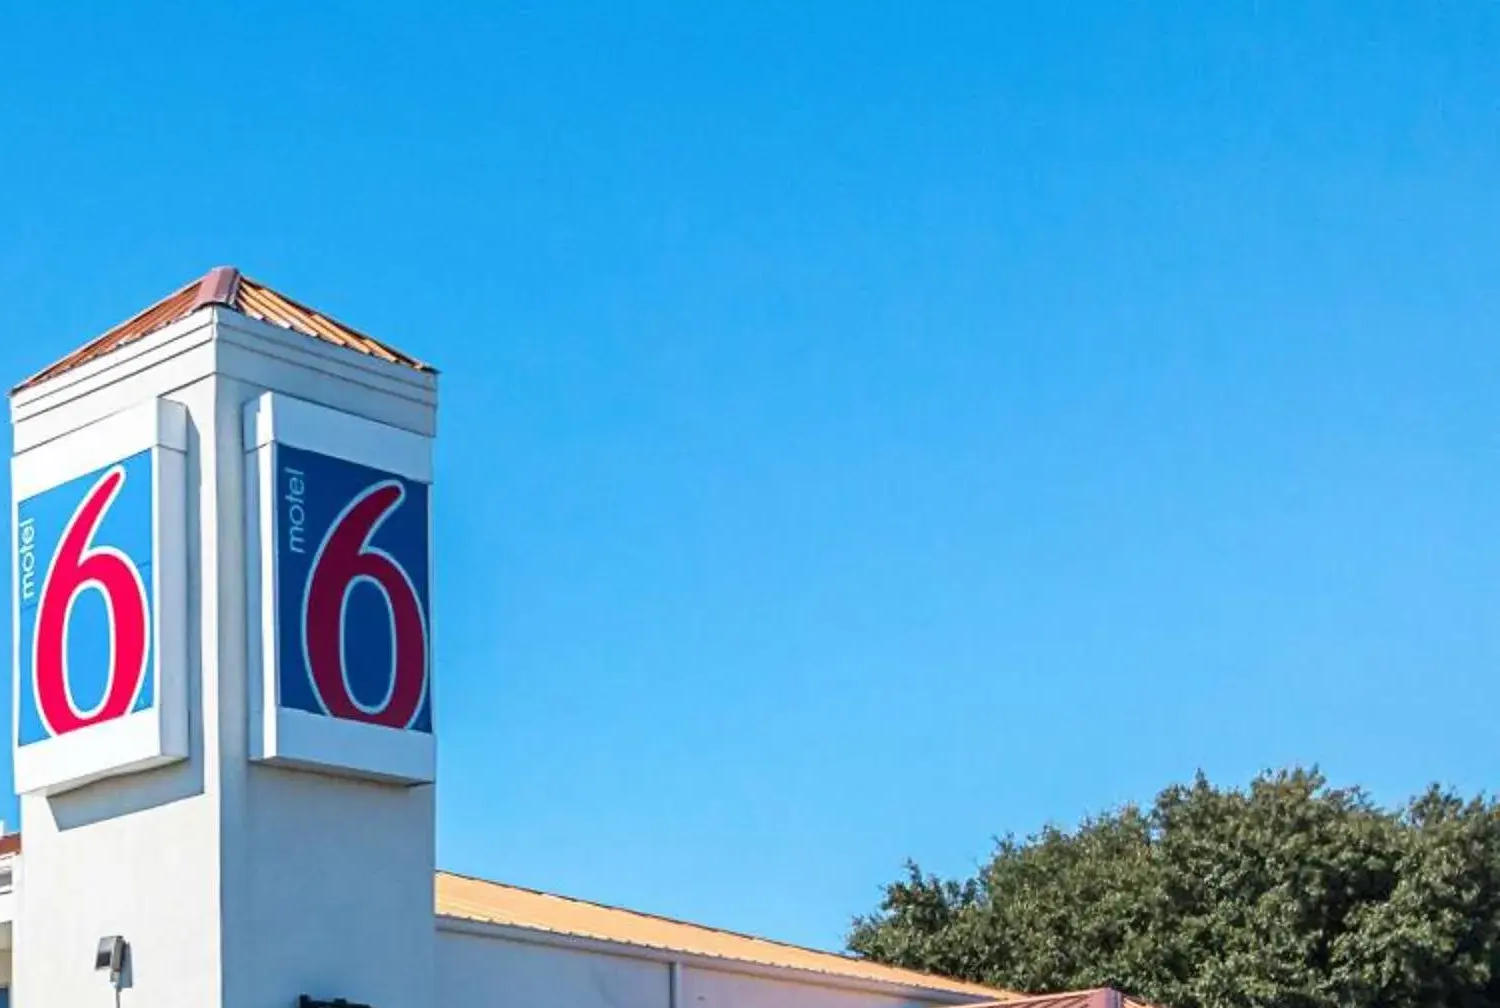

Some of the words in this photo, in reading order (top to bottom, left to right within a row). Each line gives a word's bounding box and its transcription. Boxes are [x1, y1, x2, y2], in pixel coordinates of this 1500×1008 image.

[20, 518, 35, 599] motel
[33, 466, 149, 736] 6
[284, 466, 306, 554] motel
[304, 480, 427, 730] 6
